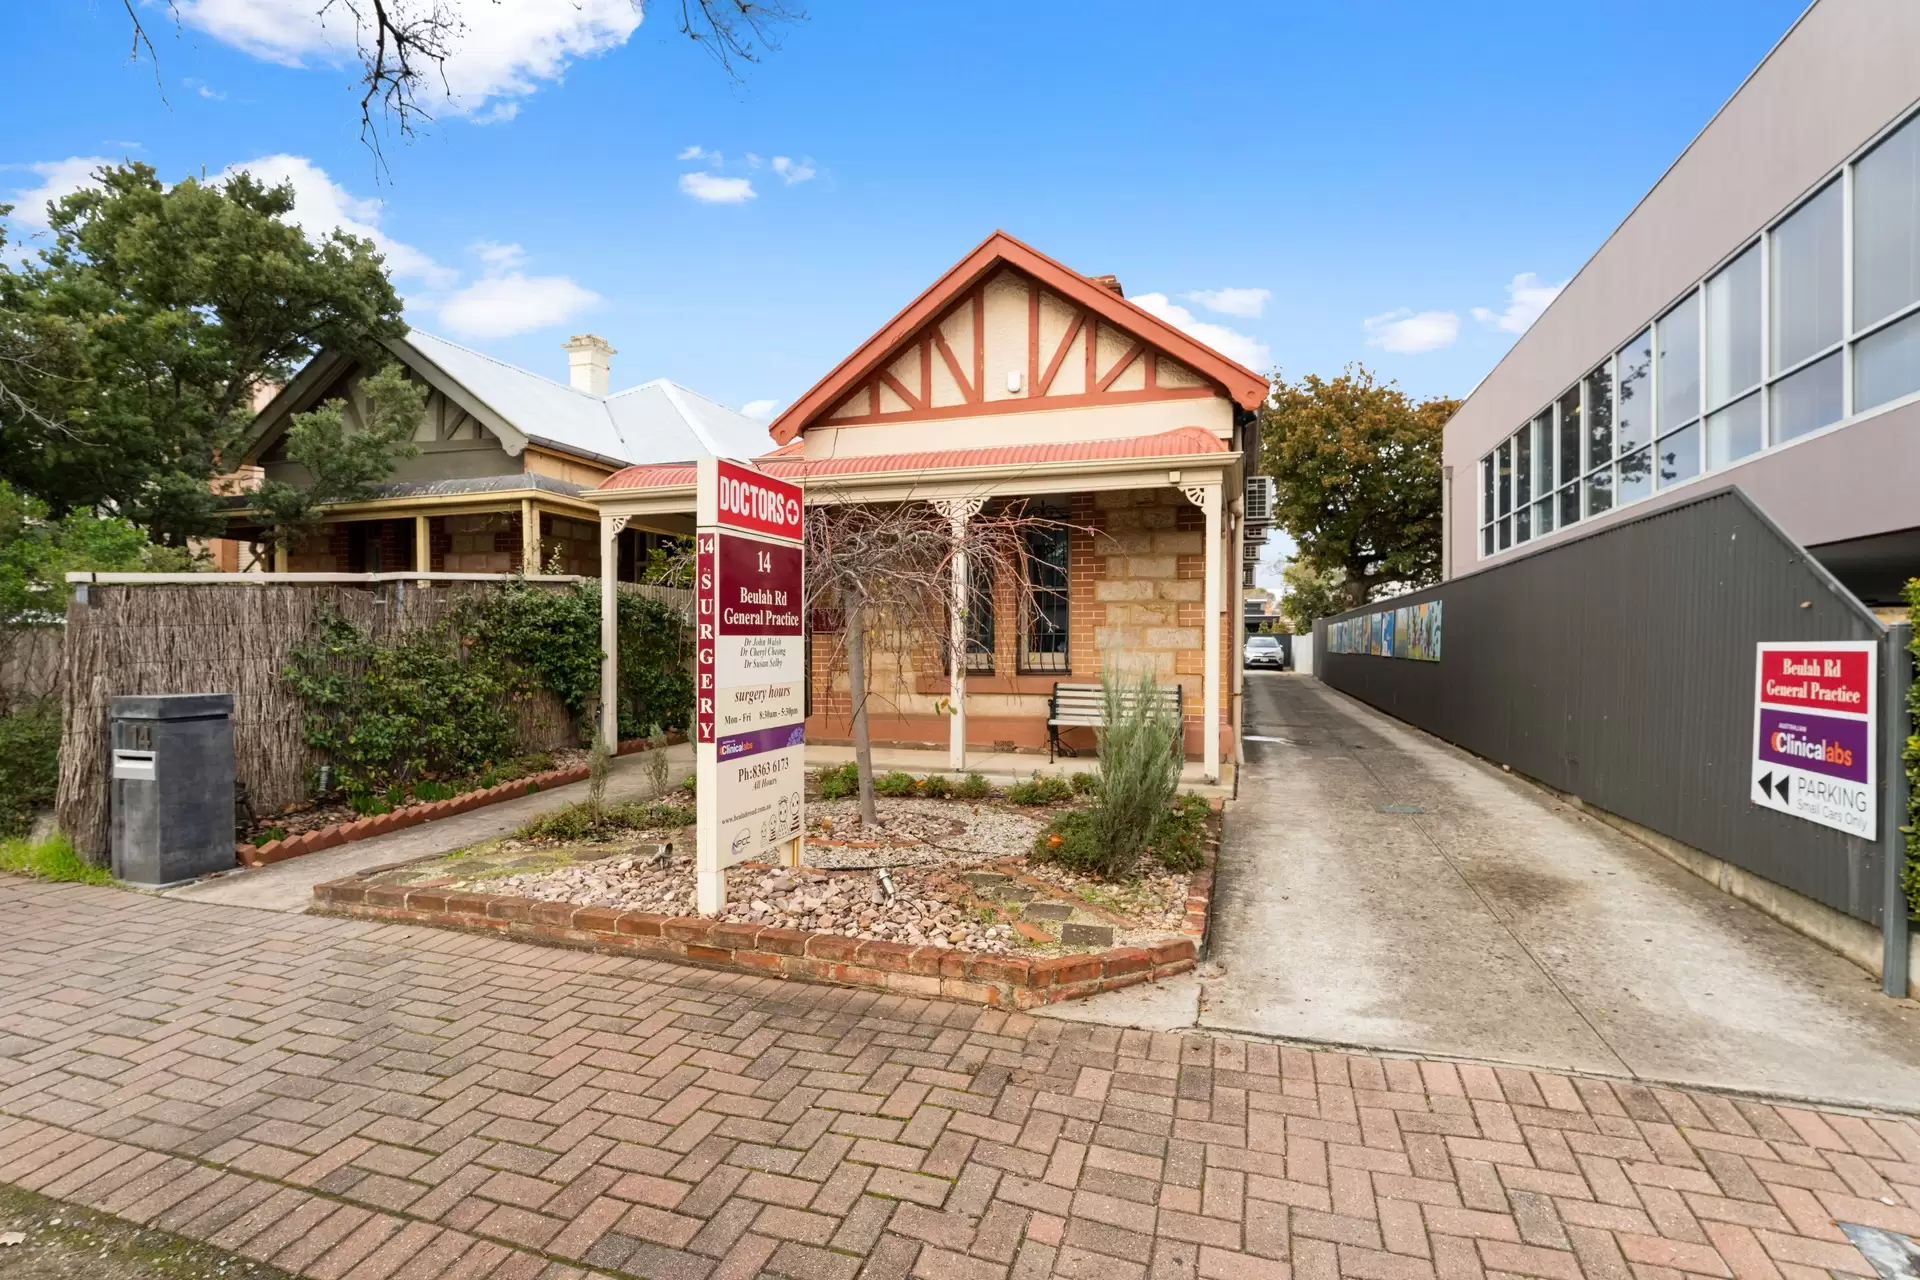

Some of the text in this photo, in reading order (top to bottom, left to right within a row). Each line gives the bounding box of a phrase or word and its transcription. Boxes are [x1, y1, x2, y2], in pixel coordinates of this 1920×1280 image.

[720, 475, 785, 525] DOCTORS
[757, 550, 772, 574] 14
[739, 586, 788, 607] Beulah Rd
[723, 607, 800, 627] General Practice
[698, 538, 714, 739] 14 SURGERY
[743, 637, 752, 647] Dr
[752, 637, 766, 646] John
[740, 646, 749, 657] Dr
[749, 647, 767, 659] Cheryl
[743, 659, 752, 669] Dr
[752, 659, 769, 669] Susan
[1782, 657, 1842, 678] Beulah Rd
[734, 684, 792, 705] surgery hours
[1765, 678, 1862, 704] General Practice
[724, 715, 738, 725] Mon
[742, 713, 752, 723] Fri
[130, 725, 152, 751] 14
[1772, 731, 1853, 767] Clinicalabs
[772, 757, 790, 773] 6173
[761, 777, 778, 789] Hours
[1797, 776, 1867, 813] PARKING
[1796, 798, 1869, 832] Small Cars Only
